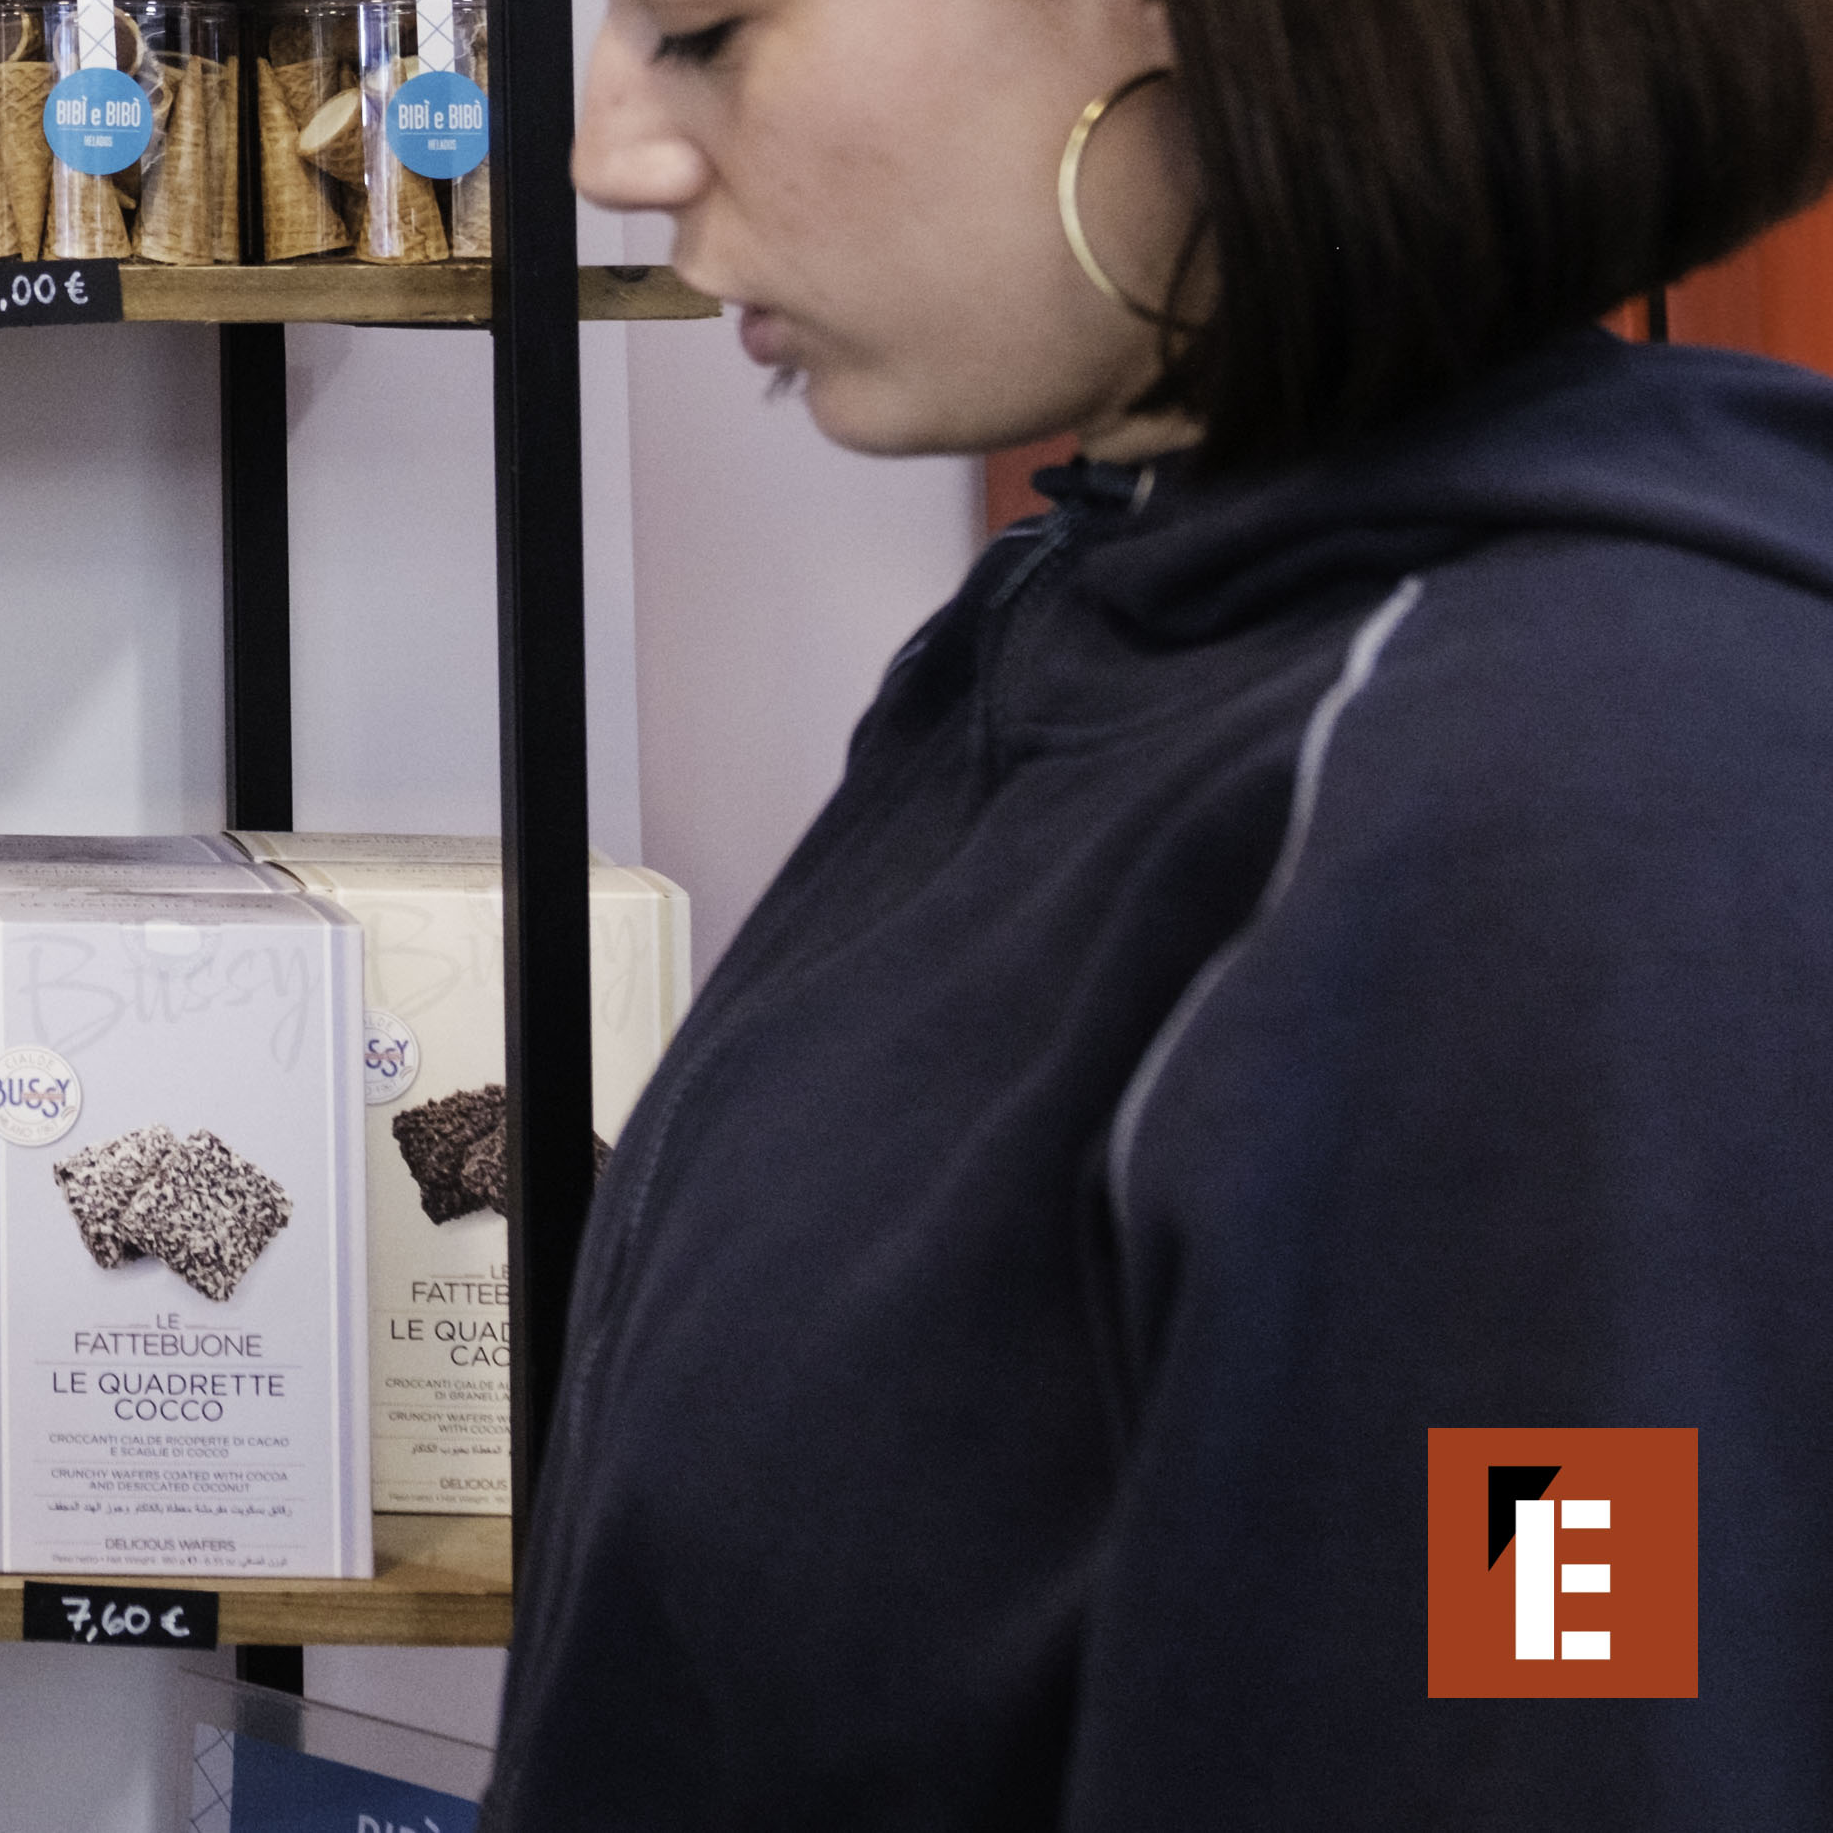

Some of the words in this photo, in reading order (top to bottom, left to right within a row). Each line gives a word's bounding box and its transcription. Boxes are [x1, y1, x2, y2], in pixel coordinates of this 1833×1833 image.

[56, 96, 87, 126] BIBÌ
[91, 107, 102, 126] e
[105, 97, 142, 128] BIBÒ
[398, 98, 431, 130] BIBÌ
[434, 111, 445, 130] e
[448, 99, 483, 130] BIBÒ
[365, 1038, 410, 1078] SSY
[156, 1313, 181, 1331] LE
[74, 1332, 263, 1358] FATTEBUONE
[52, 1371, 88, 1394] LE
[98, 1372, 286, 1397] QUADRETTE
[385, 1378, 449, 1390] CROCCANTI
[454, 1379, 494, 1391] CIALDE
[114, 1399, 224, 1422] COCCO
[388, 1412, 443, 1423] CRUNCHY
[447, 1413, 493, 1424] WAFERS
[49, 1434, 118, 1446] CROCCANTI
[120, 1435, 163, 1447] CIALDE
[165, 1436, 230, 1448] RICOPERTE
[232, 1437, 246, 1447] DI
[247, 1437, 290, 1448] CACAO
[110, 1447, 117, 1457] E
[119, 1447, 171, 1458] SCAGLIE
[172, 1448, 184, 1458] DI
[186, 1448, 230, 1459] COCCO
[50, 1469, 108, 1480] CRUNCHY
[111, 1470, 161, 1481] WAFERS
[163, 1471, 211, 1482] COATED
[213, 1472, 244, 1482] WITH
[245, 1472, 288, 1482] COCOA
[89, 1481, 115, 1492] AND
[117, 1482, 190, 1493] DESICCATED
[192, 1483, 252, 1494] COCONUT
[440, 1477, 508, 1491] DELICIOUS
[105, 1538, 175, 1552] DELICIOUS
[179, 1539, 236, 1553] WAFERS
